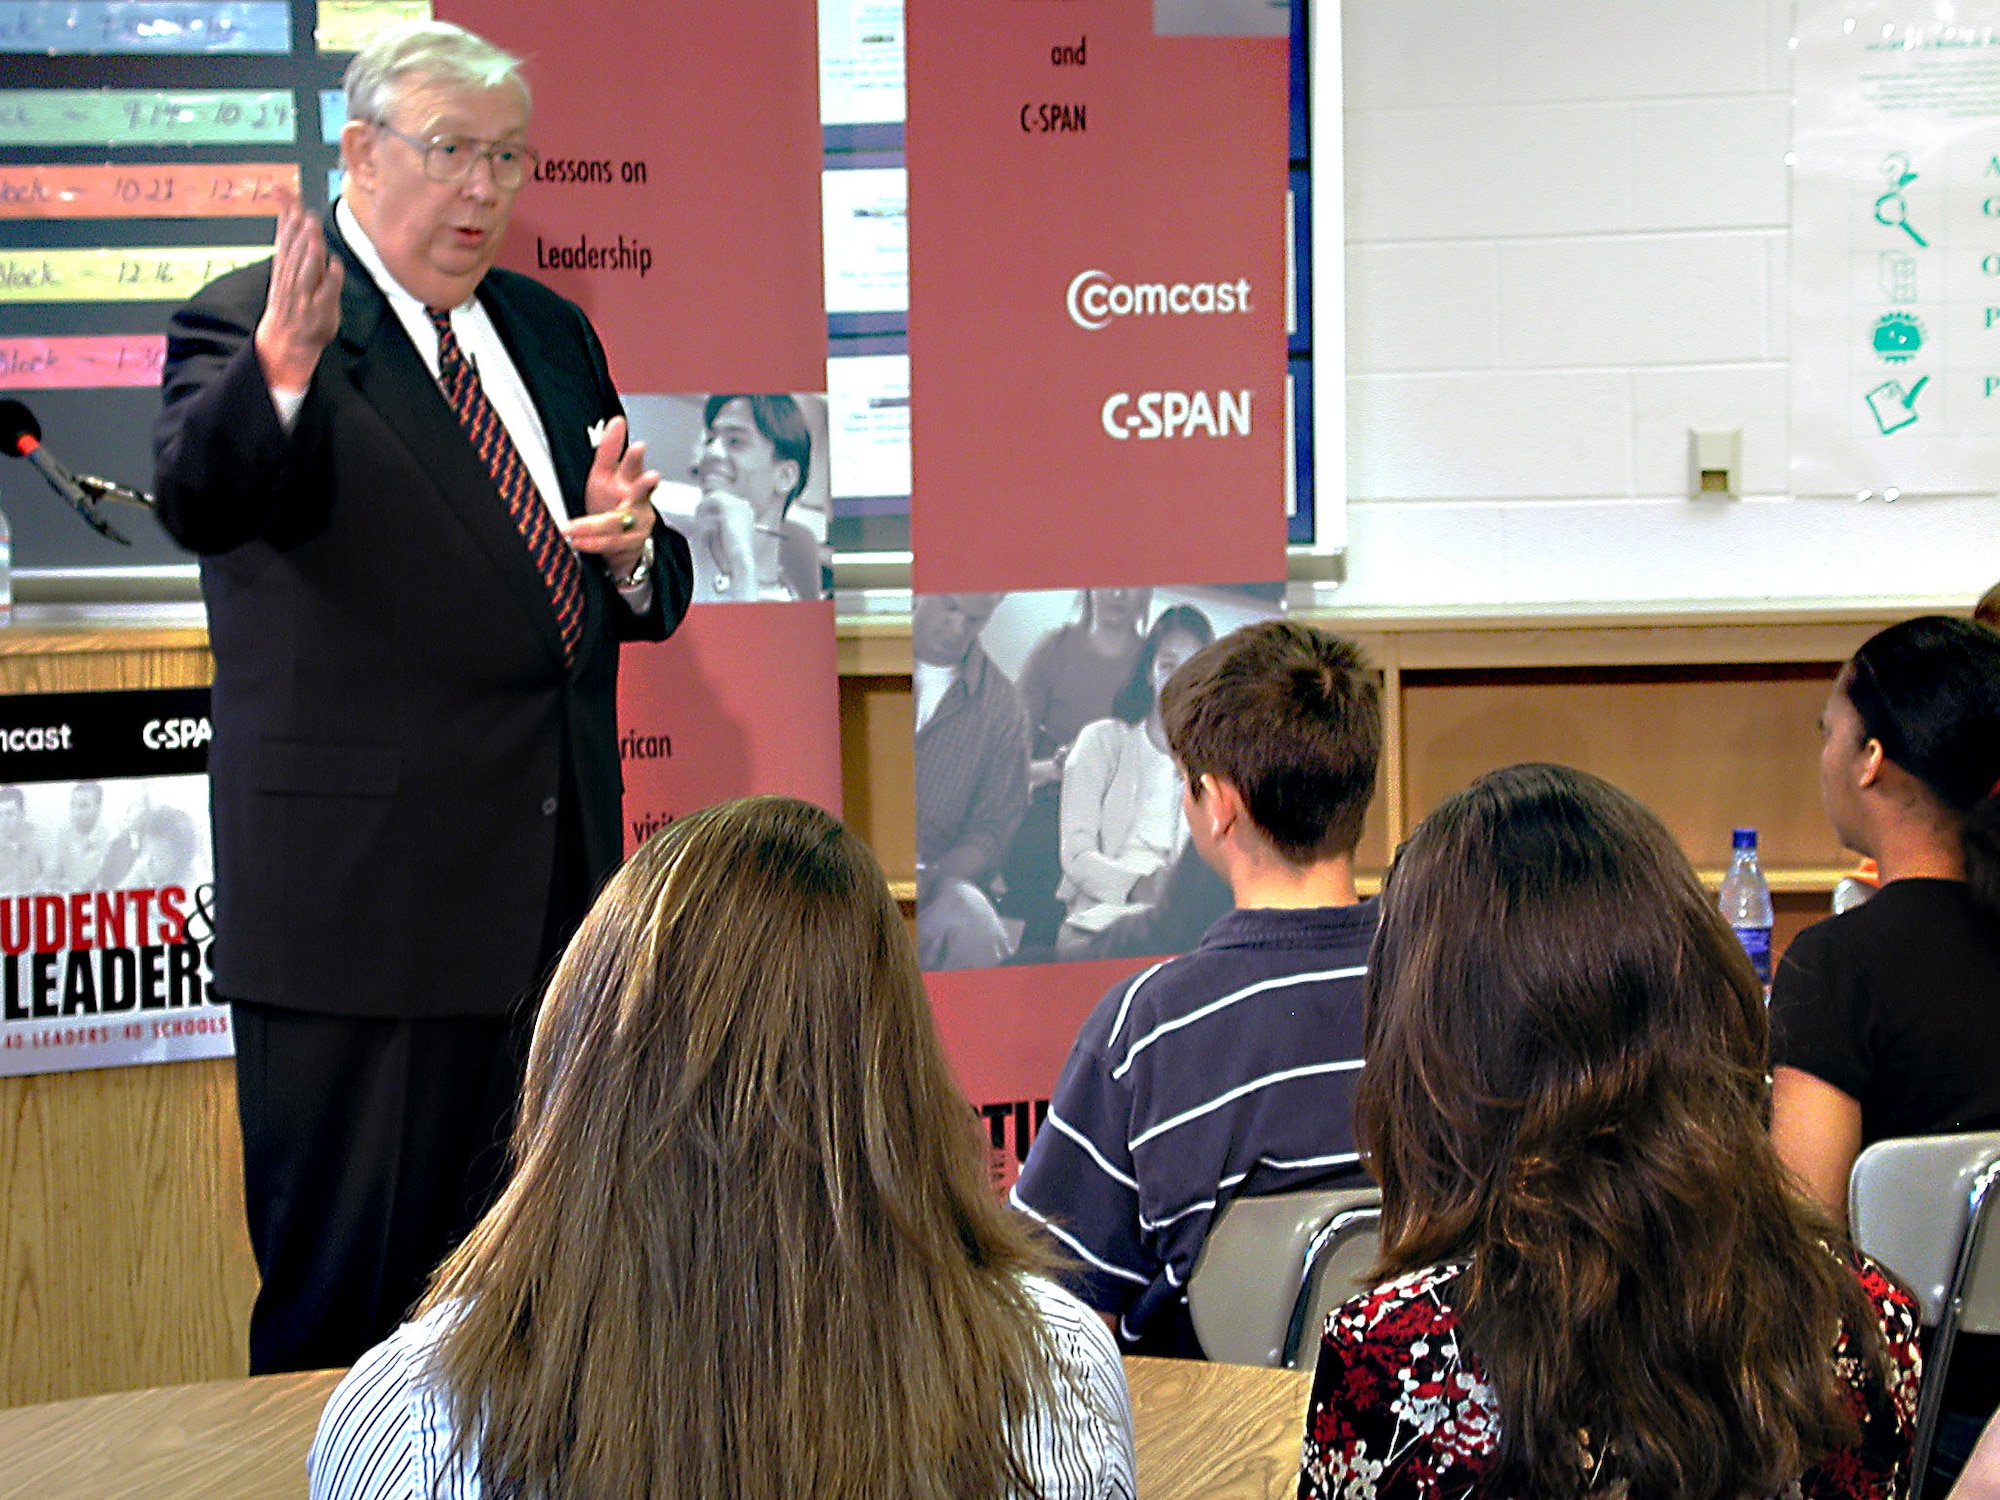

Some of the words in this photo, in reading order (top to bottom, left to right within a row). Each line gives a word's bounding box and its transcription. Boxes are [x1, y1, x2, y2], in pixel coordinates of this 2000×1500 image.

[1051, 36, 1087, 66] and
[1021, 104, 1087, 132] C-SPAN
[533, 159, 613, 183] Lessons
[621, 161, 646, 184] on
[536, 234, 653, 279] Leadership
[1101, 389, 1255, 440] C-SPAN
[32, 1025, 109, 1049] LEADERS
[152, 1015, 228, 1039] SCHOOLS
